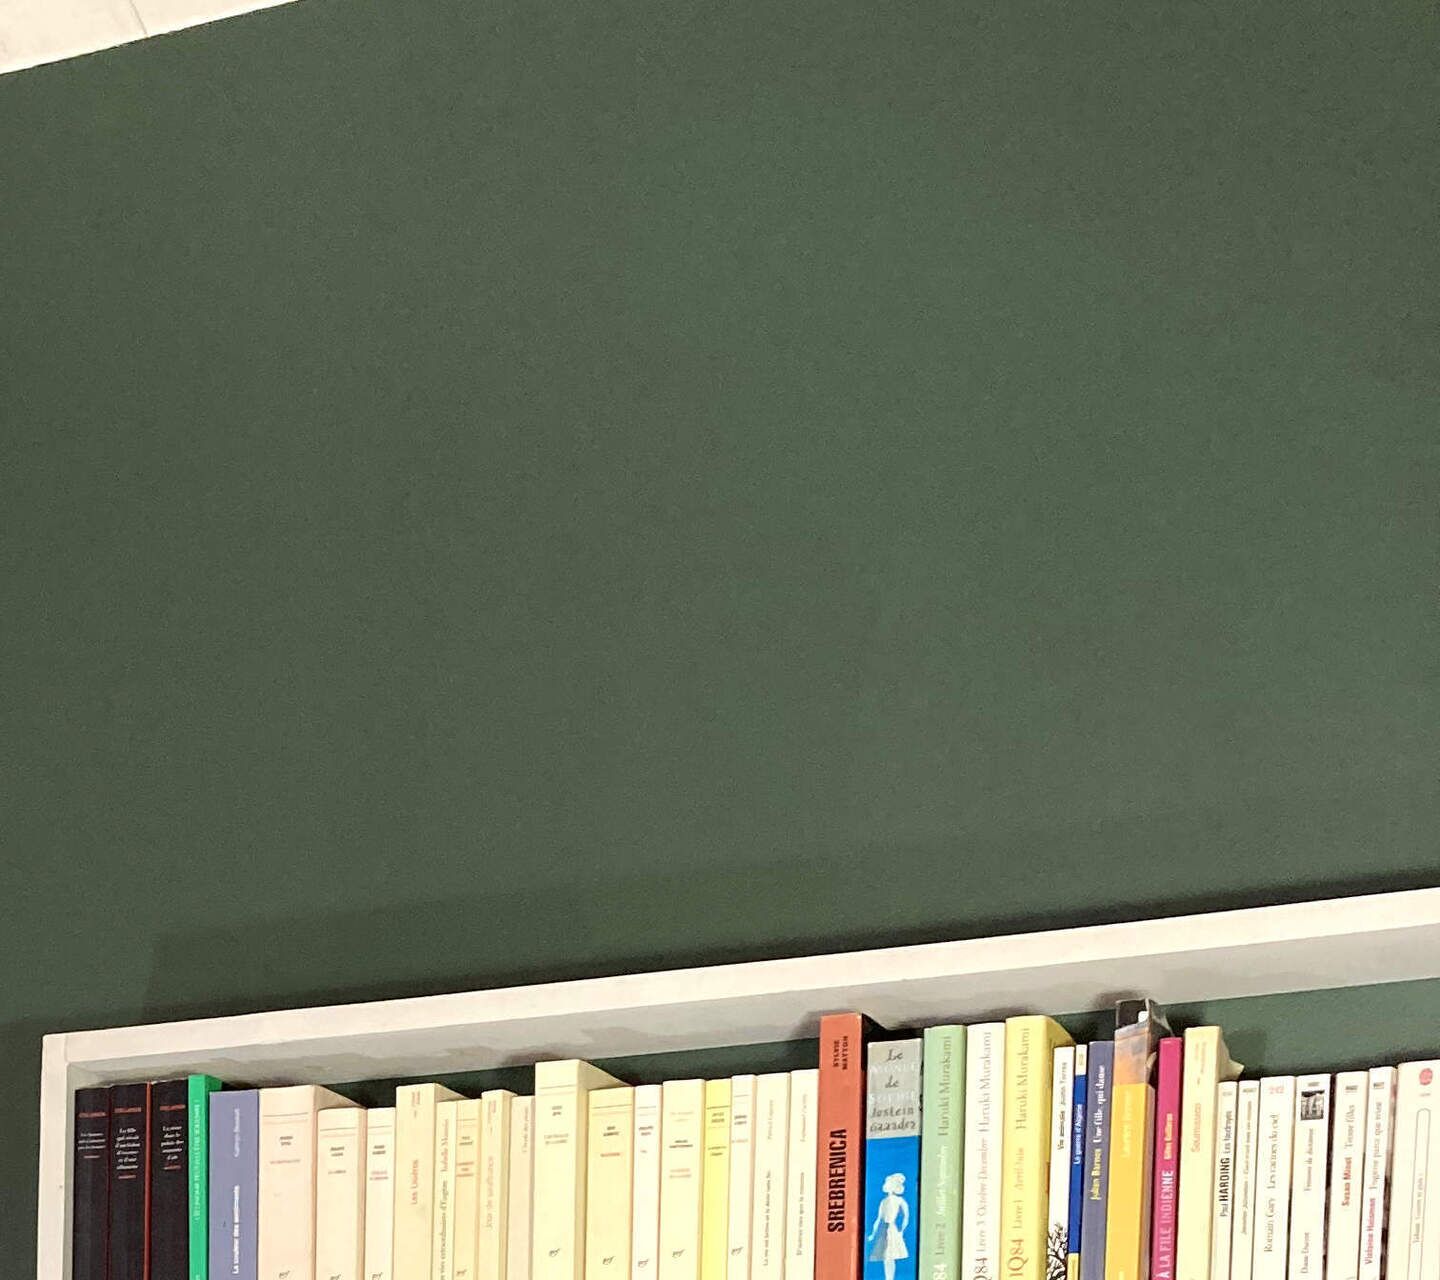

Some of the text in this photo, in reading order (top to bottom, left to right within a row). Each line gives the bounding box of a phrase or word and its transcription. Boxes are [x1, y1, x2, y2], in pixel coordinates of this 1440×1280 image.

[939, 1034, 952, 1093] Murakami
[980, 1031, 993, 1091] Murakami
[1016, 1026, 1030, 1087] Murakami
[938, 1096, 951, 1136] Haruki
[979, 1092, 993, 1132] Haruki
[1015, 1088, 1029, 1130] Haruki
[827, 1127, 848, 1234] SREBRENICA
[1161, 1168, 1173, 1223] INDIENNE
[1219, 1156, 1230, 1201] HARDING
[1160, 1225, 1173, 1251] FILE
[1160, 1253, 1171, 1267] LA
